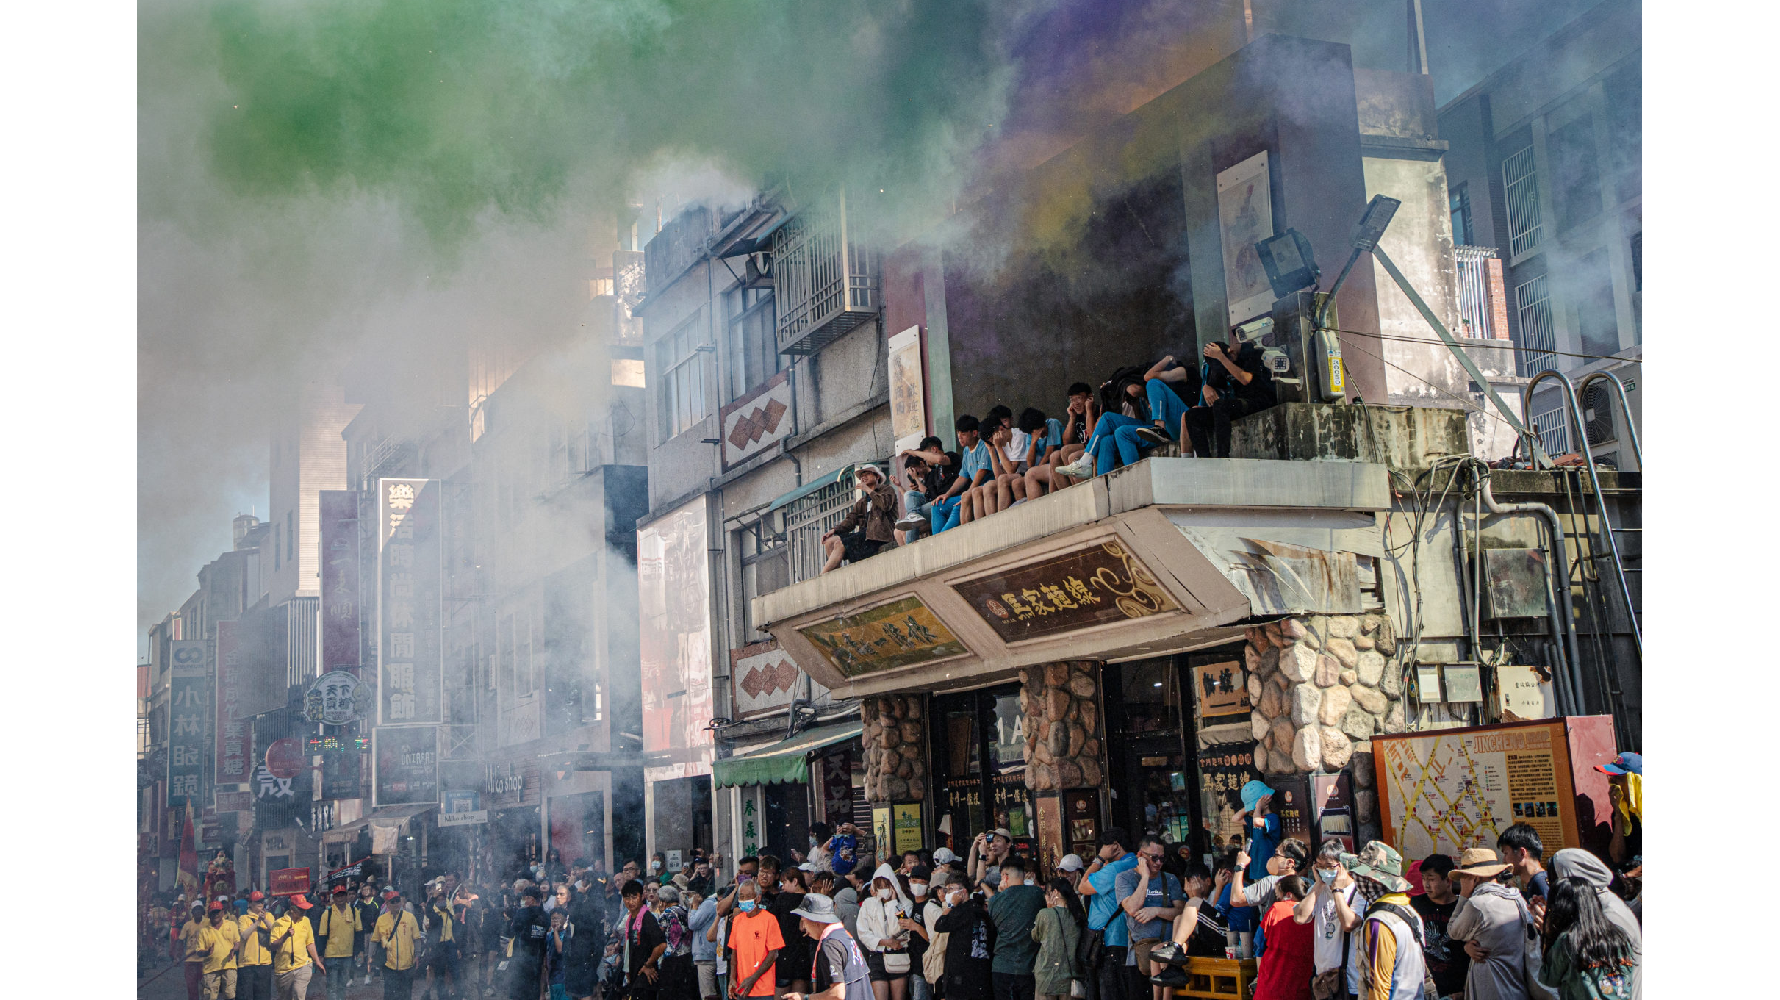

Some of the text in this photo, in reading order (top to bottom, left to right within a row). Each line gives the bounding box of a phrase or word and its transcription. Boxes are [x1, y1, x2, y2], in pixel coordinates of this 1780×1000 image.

[1001, 576, 1101, 622] 馬家麵線
[172, 685, 202, 798] 小林眼鏡
[1473, 731, 1525, 754] JINCHENG
[504, 761, 523, 802] shop
